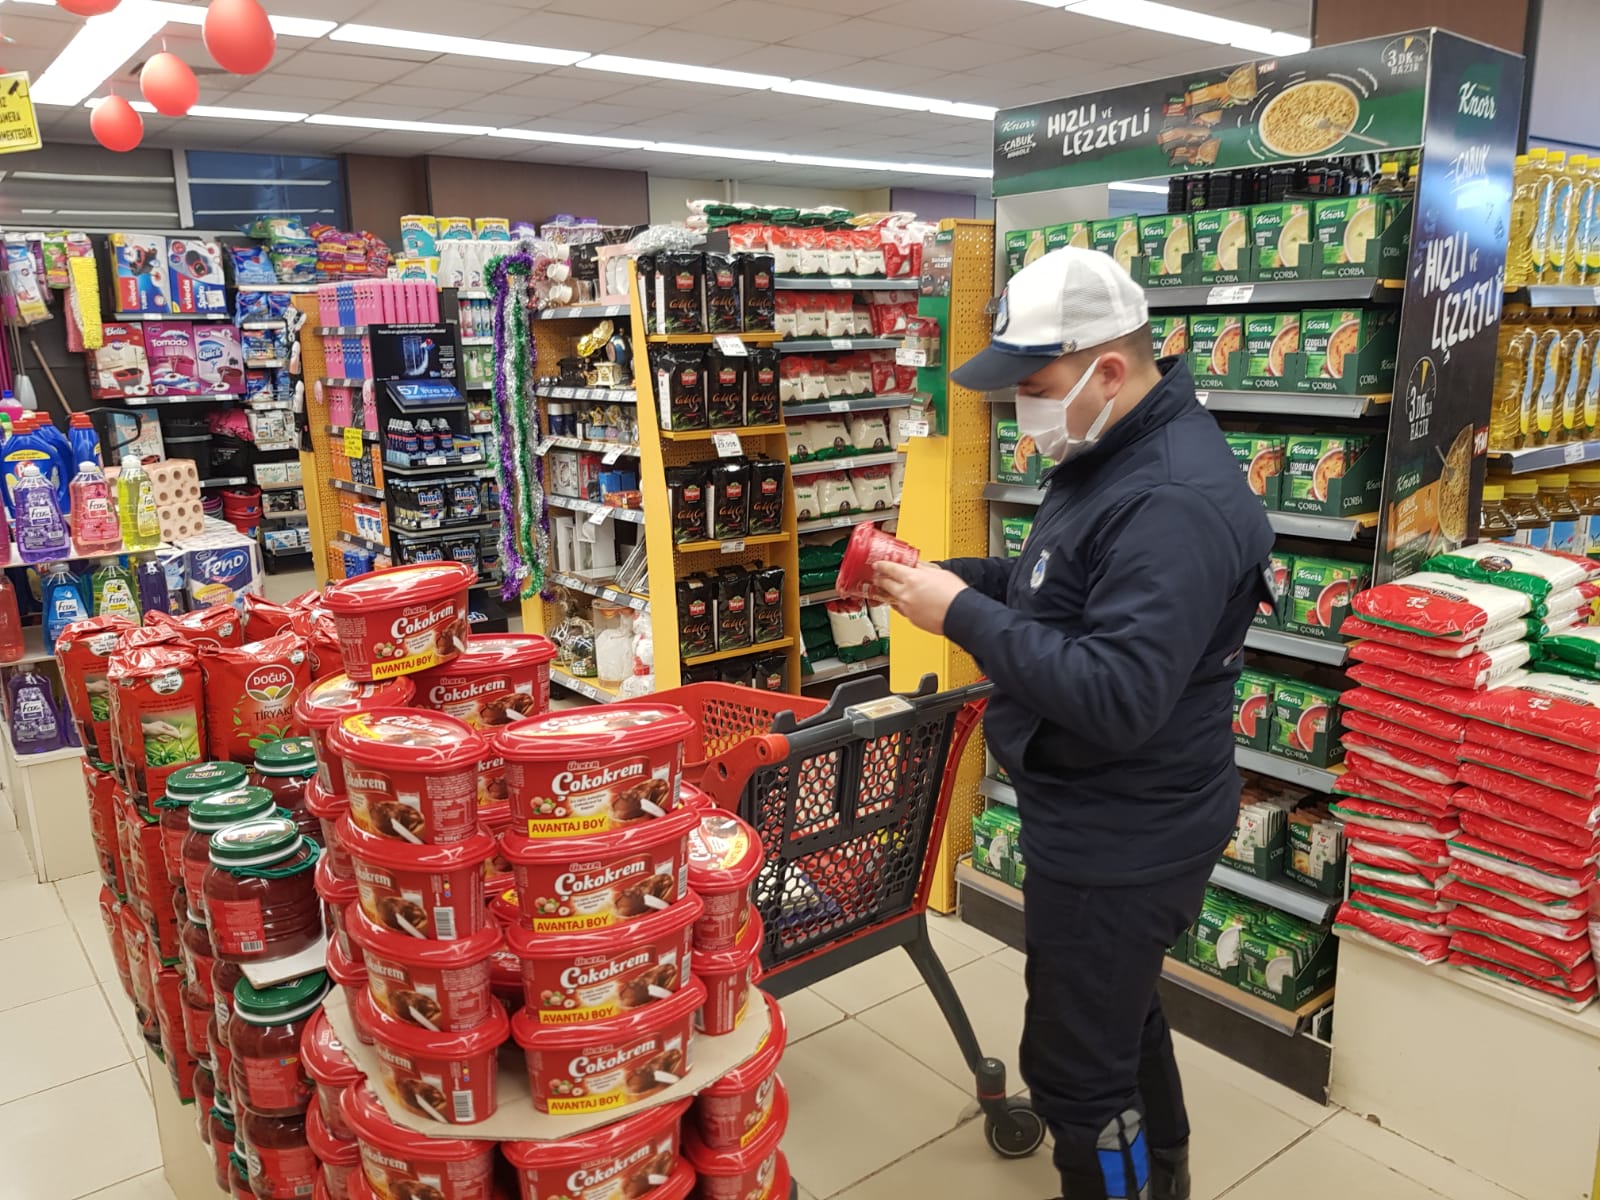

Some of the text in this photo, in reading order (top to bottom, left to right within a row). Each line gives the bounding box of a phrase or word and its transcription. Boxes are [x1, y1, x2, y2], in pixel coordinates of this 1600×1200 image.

[1458, 80, 1497, 120] Knorr
[1001, 118, 1038, 132] Knorr
[1047, 104, 1113, 138] HIZLI VE
[1062, 107, 1151, 157] LEZZETLİ
[1256, 214, 1280, 225] Knorr
[1319, 210, 1346, 221] Knorr
[1338, 267, 1365, 277] ÇORBA
[1423, 231, 1469, 297] HIZLI
[1160, 277, 1182, 286] ÇORBA
[1216, 274, 1239, 283] ÇORBA
[1273, 270, 1299, 280] ÇORBA
[1306, 320, 1331, 330] Knorr
[1255, 378, 1279, 388] ÇORBA
[1311, 380, 1338, 391] ÇORBA
[1292, 445, 1318, 455] Knorr
[1298, 502, 1322, 512] ÇORBA
[390, 605, 454, 645] Çokokrem
[1300, 626, 1325, 637] ÇORBA
[375, 654, 433, 676] AVANTAJ BOY
[253, 671, 287, 687] DOĞUŞ
[429, 680, 506, 709] Çokokrem
[551, 762, 644, 801] Çokokrem
[531, 816, 606, 834] AVANTAJ BOY
[554, 860, 646, 901] Çokokrem
[536, 915, 610, 932] AVANTAJ BOY
[559, 952, 650, 995] Çokokrem
[542, 1006, 615, 1024] AVANTAJ BOY
[568, 1039, 656, 1083] Çokokrem
[550, 1094, 622, 1112] AVANTAJ BOY
[566, 1145, 650, 1197] Çokokrem
